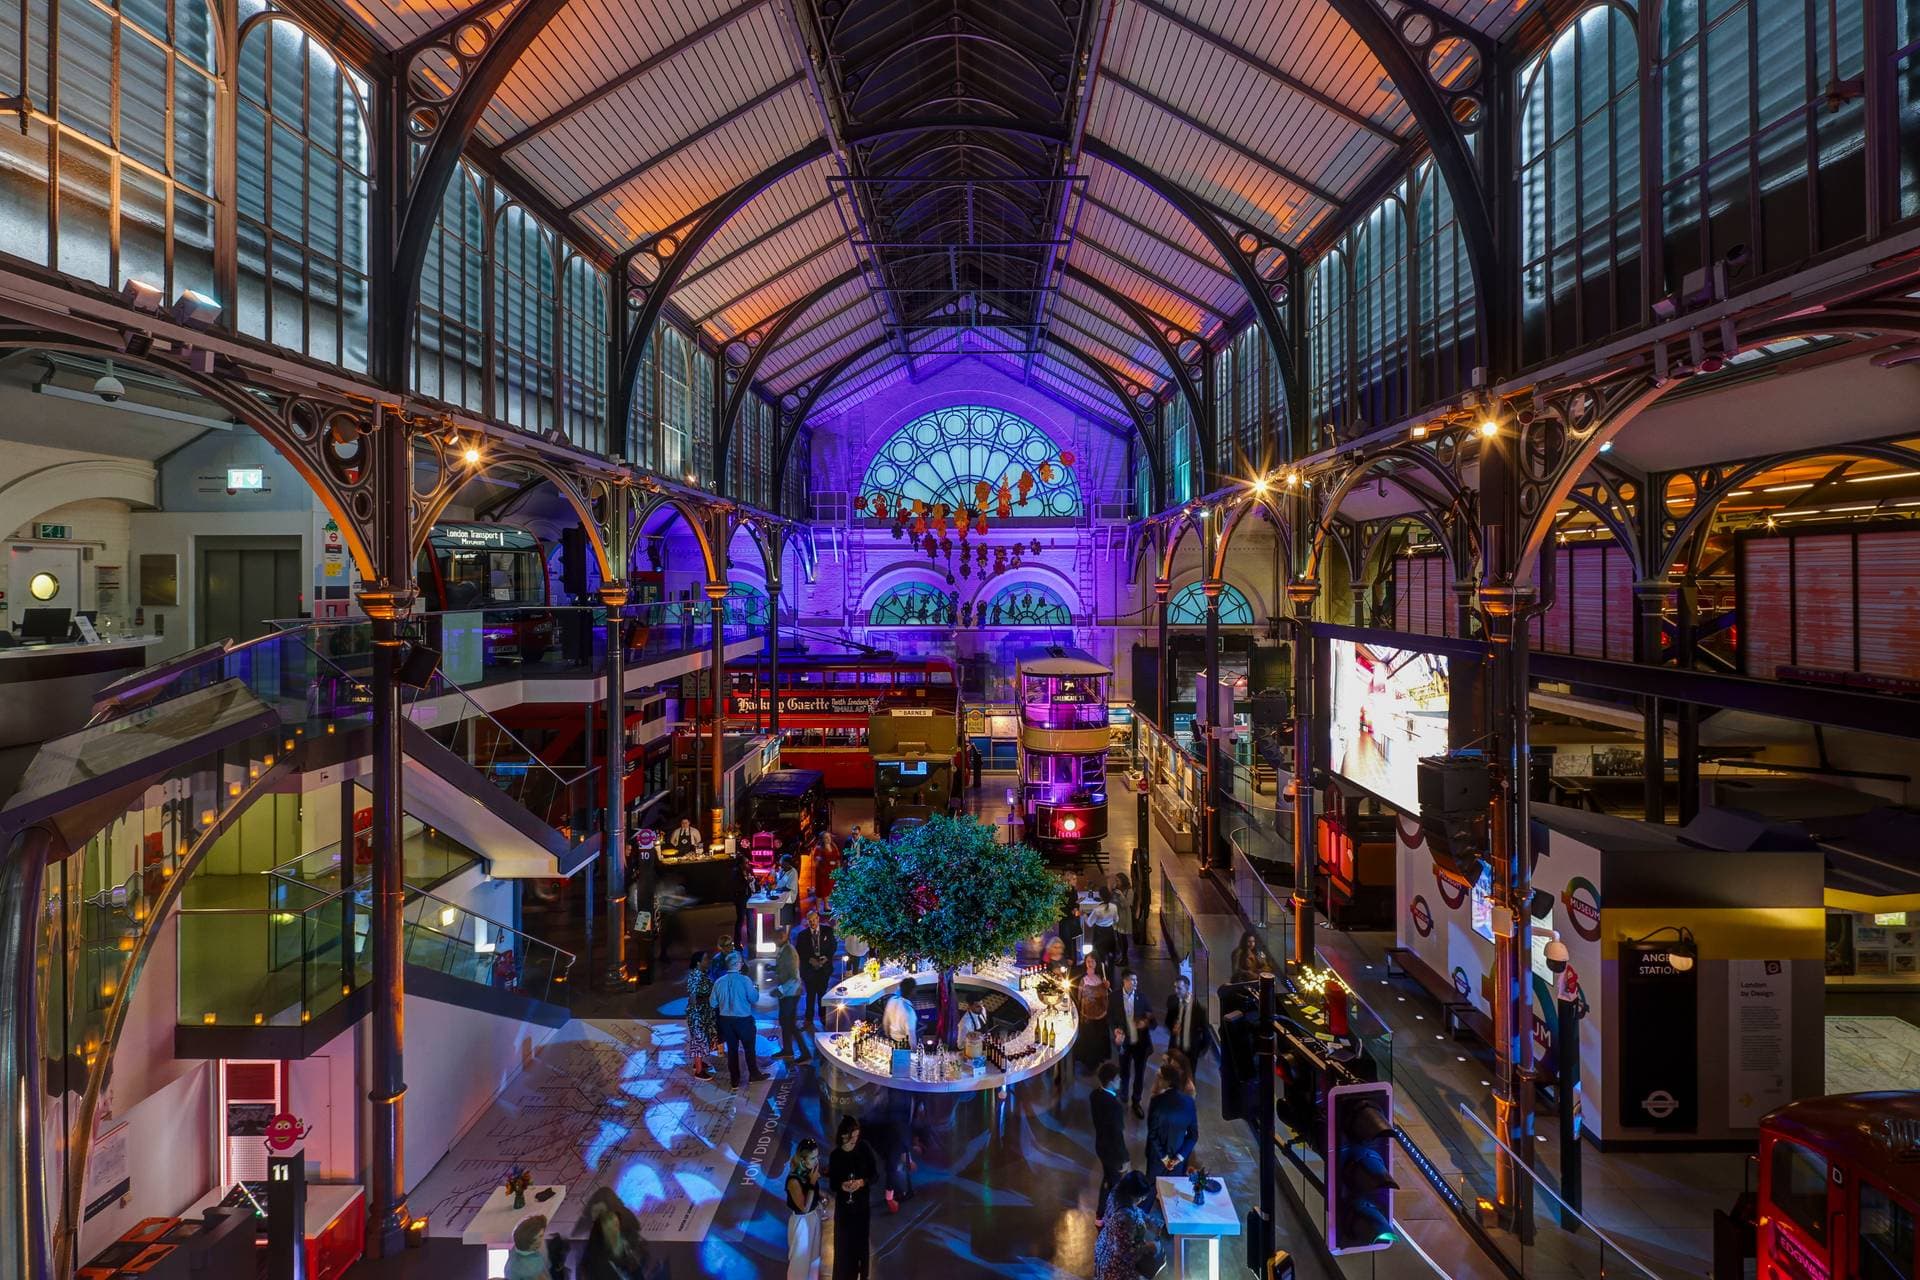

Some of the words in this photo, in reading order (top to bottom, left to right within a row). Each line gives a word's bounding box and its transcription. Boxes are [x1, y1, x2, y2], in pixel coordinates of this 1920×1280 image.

[446, 529, 469, 538] London
[470, 530, 499, 540] Transport
[787, 697, 830, 711] Gazette
[640, 852, 650, 860] 10
[1571, 897, 1600, 920] MUSEUM
[1641, 953, 1671, 962] ANGE
[1751, 990, 1774, 998] Design
[741, 1157, 763, 1186] HOW
[753, 1136, 772, 1156] DID
[763, 1108, 782, 1134] YOU
[272, 1164, 289, 1181] 11
